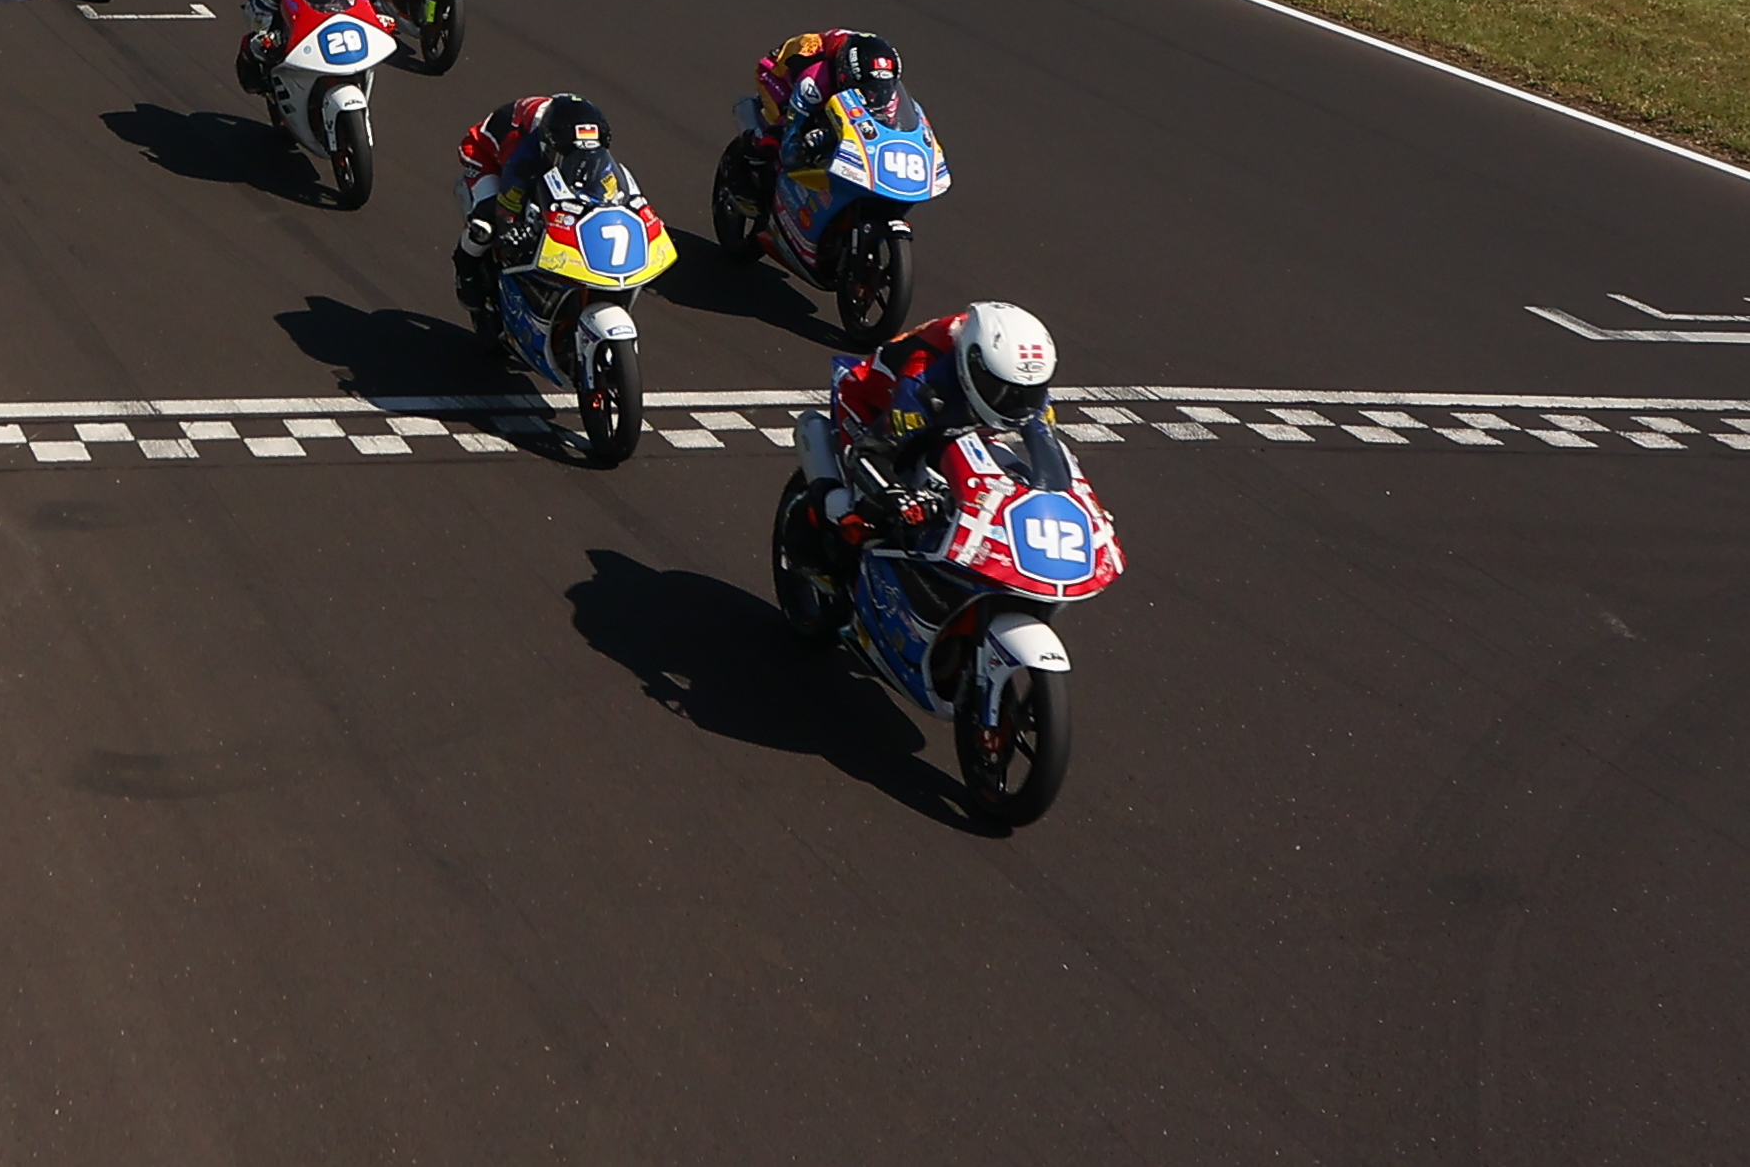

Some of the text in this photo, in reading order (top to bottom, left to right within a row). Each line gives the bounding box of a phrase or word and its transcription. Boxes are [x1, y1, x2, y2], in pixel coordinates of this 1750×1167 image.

[884, 151, 926, 181] 48
[601, 224, 630, 266] 7
[1025, 518, 1087, 563] 42
